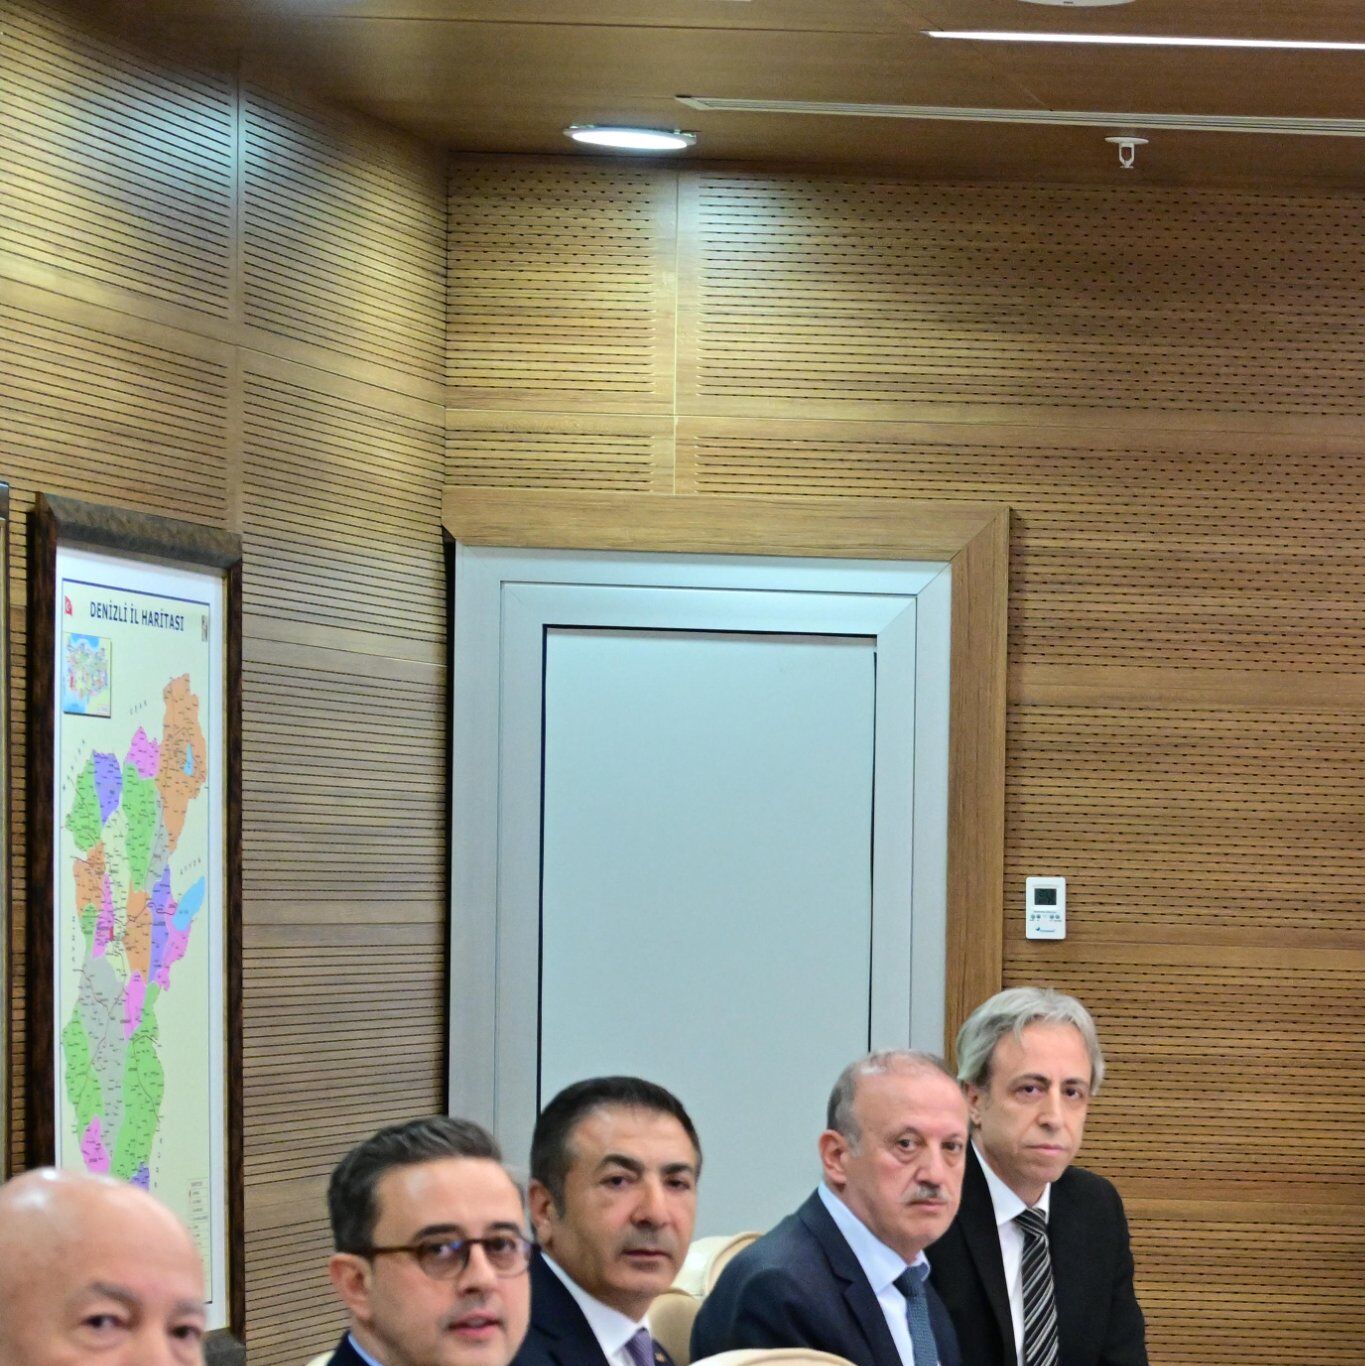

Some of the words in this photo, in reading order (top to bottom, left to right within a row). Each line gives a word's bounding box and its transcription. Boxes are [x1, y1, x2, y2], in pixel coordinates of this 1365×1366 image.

[90, 600, 127, 623] DENİZLİ
[130, 603, 139, 625] İL
[142, 608, 185, 632] HARİTASI
